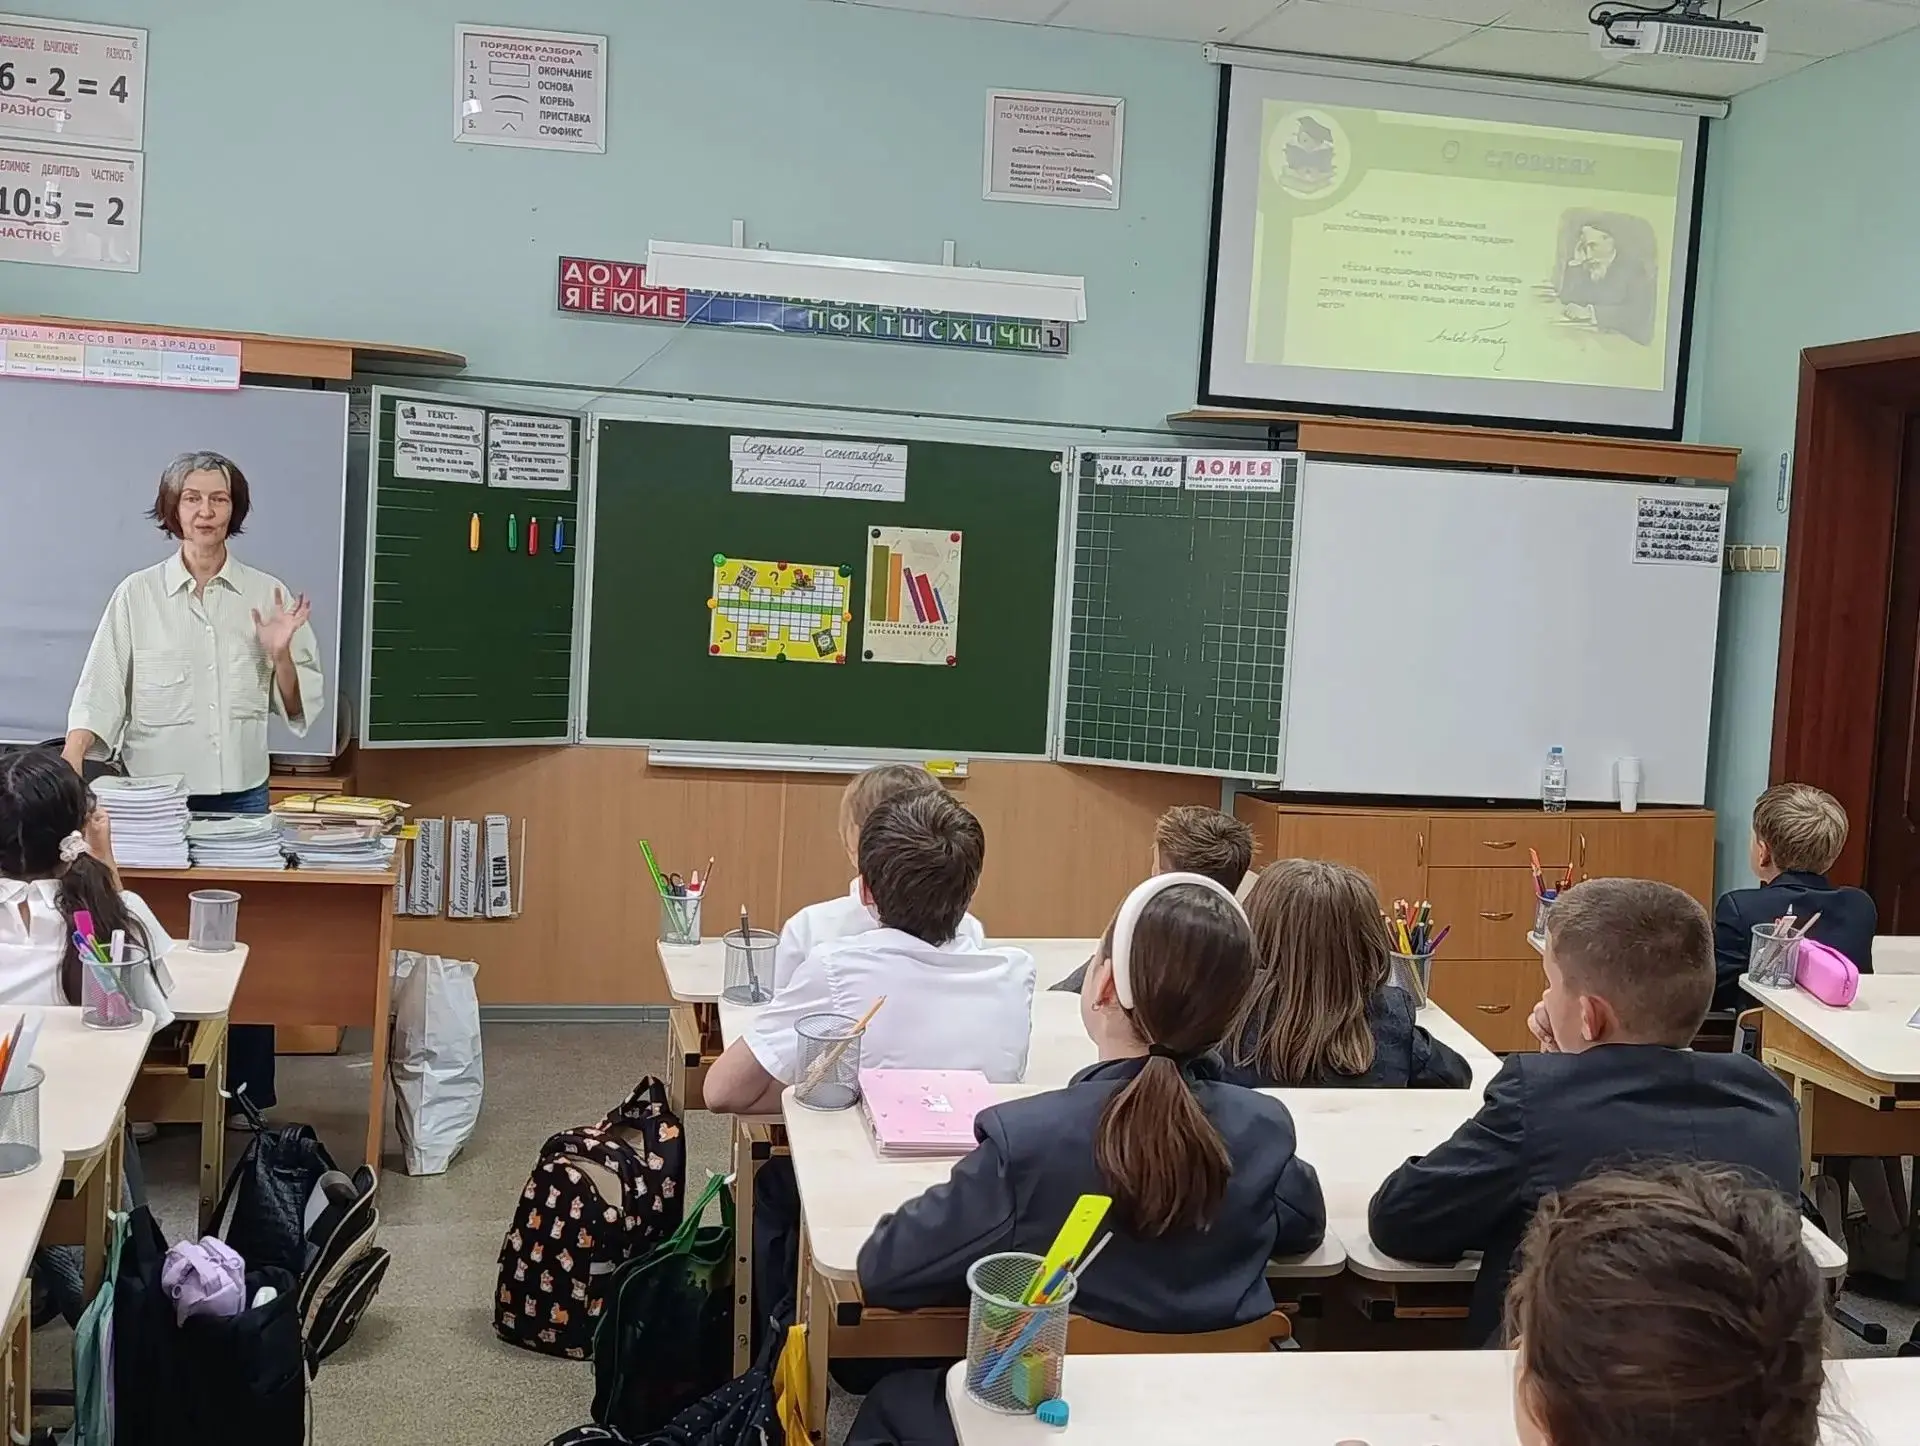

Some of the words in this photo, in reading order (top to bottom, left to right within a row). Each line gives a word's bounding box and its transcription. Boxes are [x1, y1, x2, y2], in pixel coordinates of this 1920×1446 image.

[480, 41, 533, 52] ПОРЯДОК
[535, 46, 583, 56] РАЗБОРА
[488, 51, 536, 61] СОСТАВА
[539, 56, 575, 64] СЛОВА
[538, 66, 593, 79] ОКОНЧАНИЕ
[0, 62, 15, 91] 6
[48, 67, 66, 97] 2
[109, 75, 128, 103] 4
[538, 81, 573, 92] ОСНОВА
[539, 96, 575, 107] КОРЕНЬ
[1009, 104, 1040, 113] РАЗБОР
[539, 111, 591, 123] ПРИСТАВКА
[1014, 112, 1048, 122] ЧЛЕНАМ
[539, 125, 583, 137] СУФФИКС
[41, 164, 80, 178] ДЕЛИТЕЛЬ
[91, 168, 124, 182] ЧАСТНОЕ
[107, 197, 124, 225] 2
[48, 332, 114, 344] КЛАССОВ
[141, 338, 216, 351] РАЗРЯДОВ
[743, 436, 805, 460] Седьмое
[824, 444, 895, 468] сентября
[735, 468, 807, 488] Классная
[822, 474, 884, 495] работа
[492, 855, 507, 887] ЦЕНА
